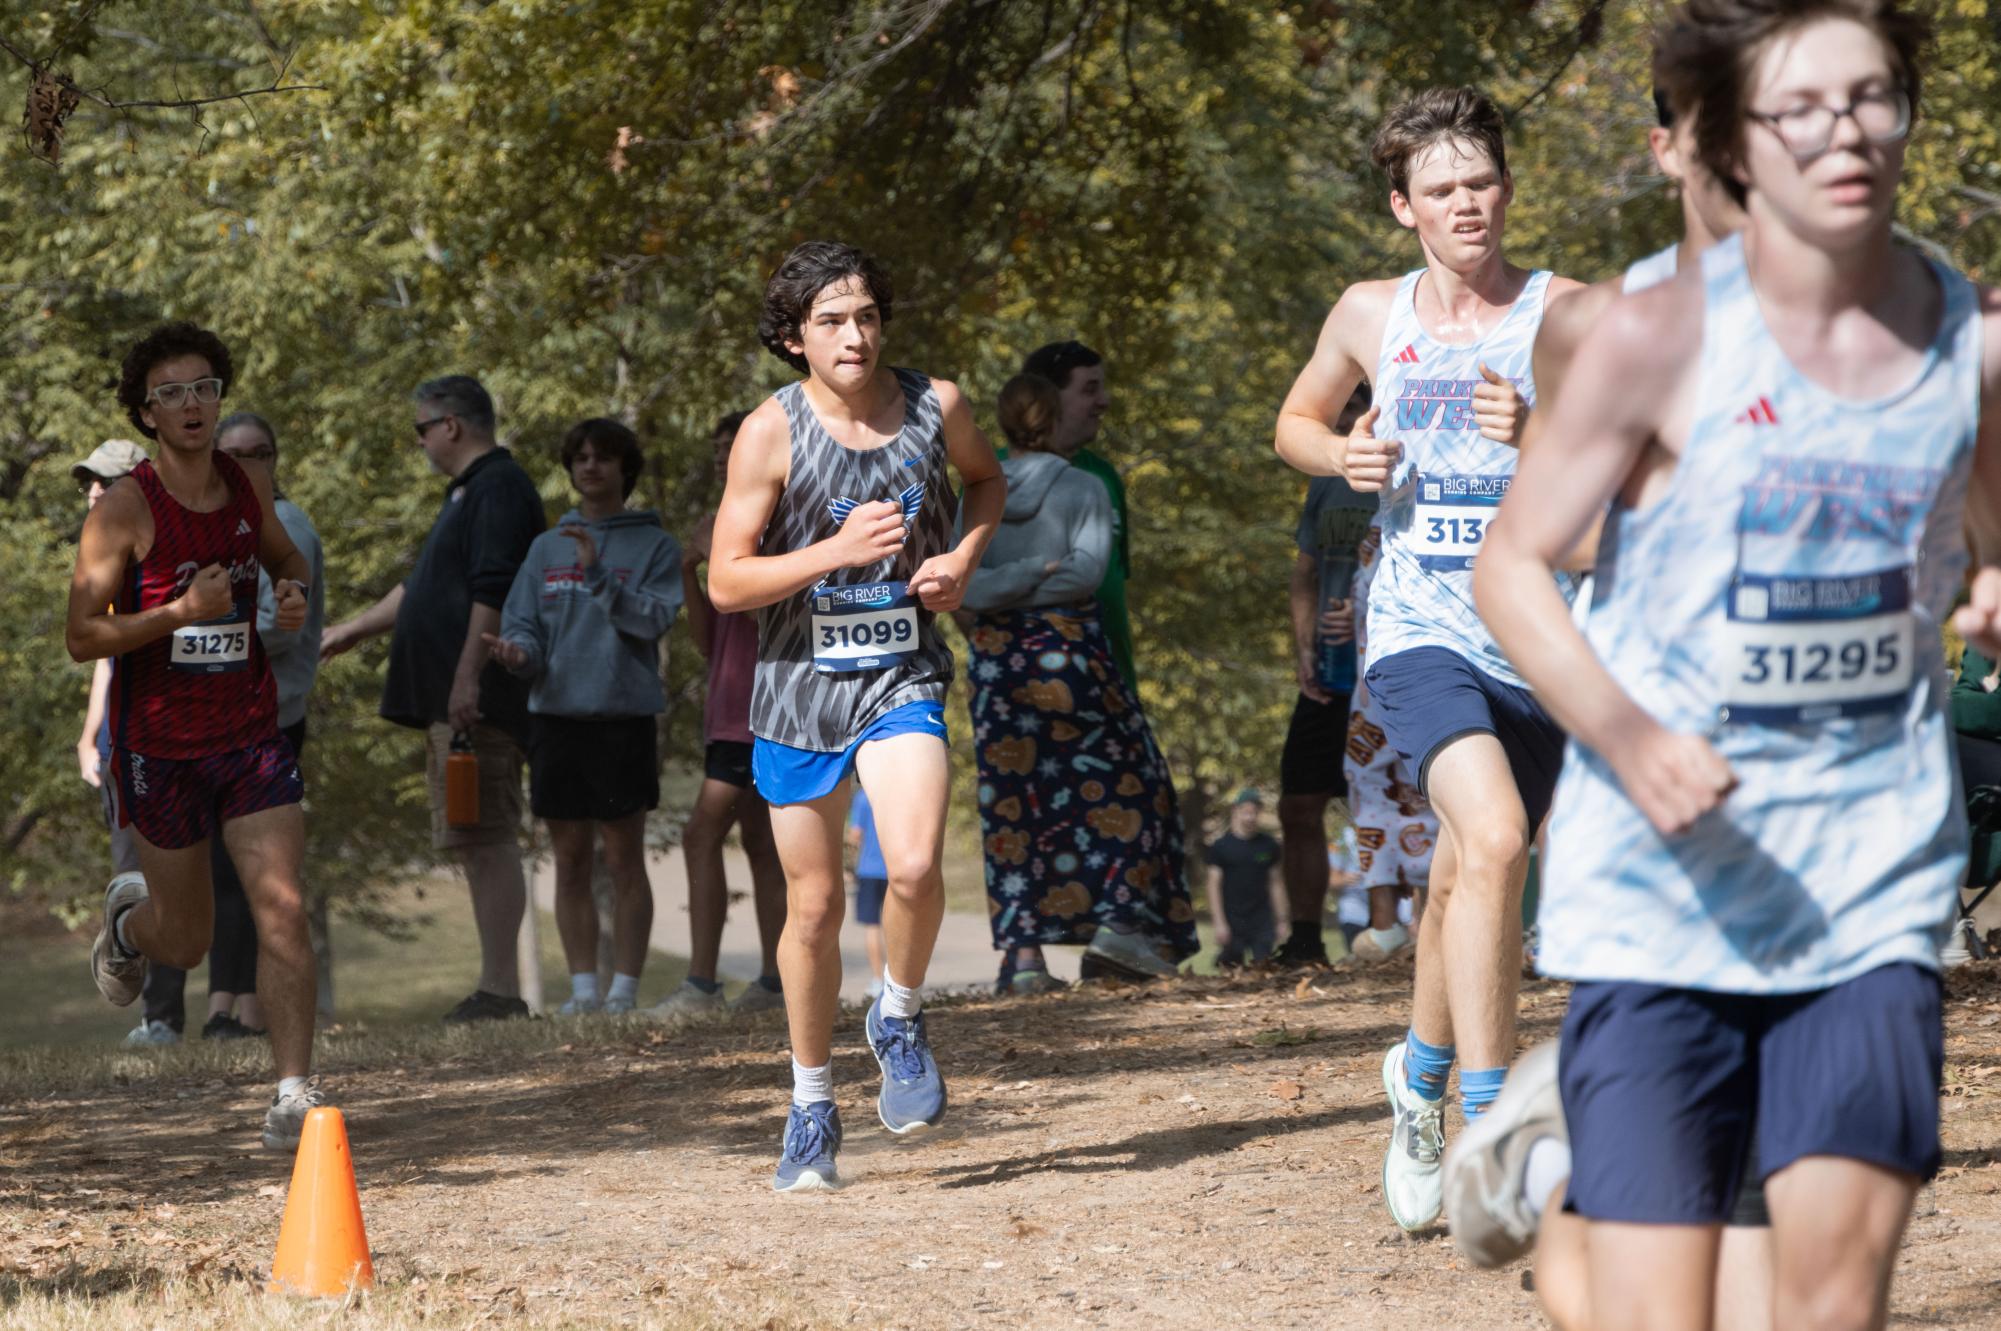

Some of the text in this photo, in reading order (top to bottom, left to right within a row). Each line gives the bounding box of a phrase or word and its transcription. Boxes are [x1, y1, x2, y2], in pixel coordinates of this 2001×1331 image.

[1401, 378, 1522, 397] PARK
[1396, 399, 1484, 430] WE
[1443, 478, 1512, 492] BIG RIVER
[1426, 517, 1489, 545] 313
[175, 553, 258, 588] Piots
[832, 586, 891, 601] BIG RIVER
[1770, 578, 1813, 604] BIG
[181, 631, 245, 655] 31275
[820, 618, 912, 649] 31099
[1741, 633, 1899, 685] 31295
